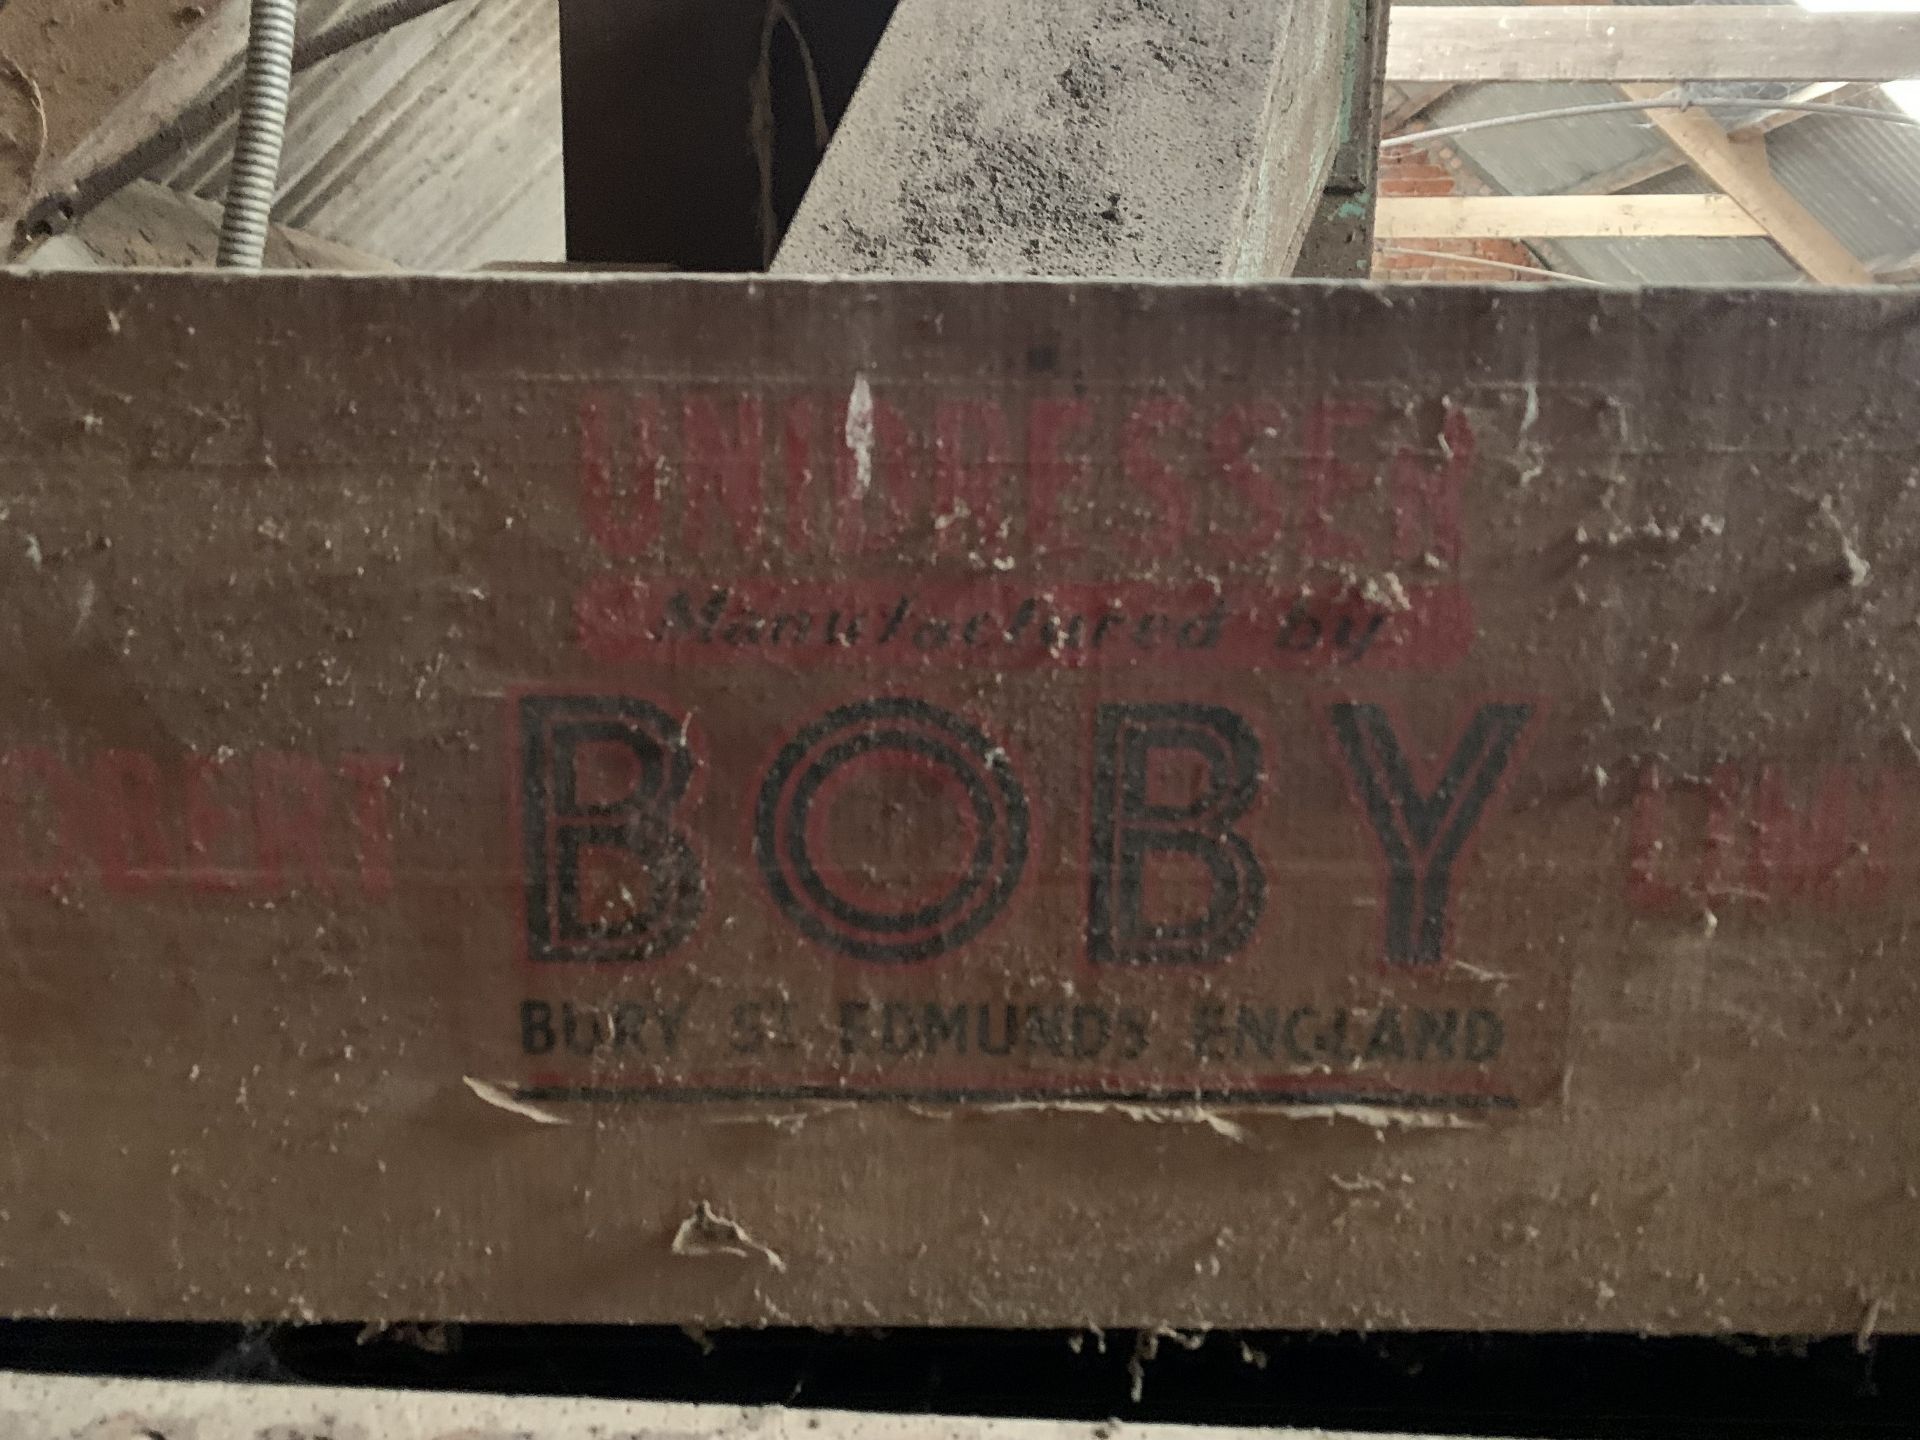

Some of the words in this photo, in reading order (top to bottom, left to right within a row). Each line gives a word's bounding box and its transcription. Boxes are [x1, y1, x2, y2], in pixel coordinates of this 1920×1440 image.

[578, 392, 1474, 560] UNIDRESSER
[655, 588, 1229, 652] Manufactured
[1274, 588, 1386, 662] by
[517, 694, 1535, 968] BOBY
[520, 999, 690, 1058] BURY
[838, 999, 1150, 1058] EDMUNDS
[1192, 1003, 1506, 1062] ENGLAND
